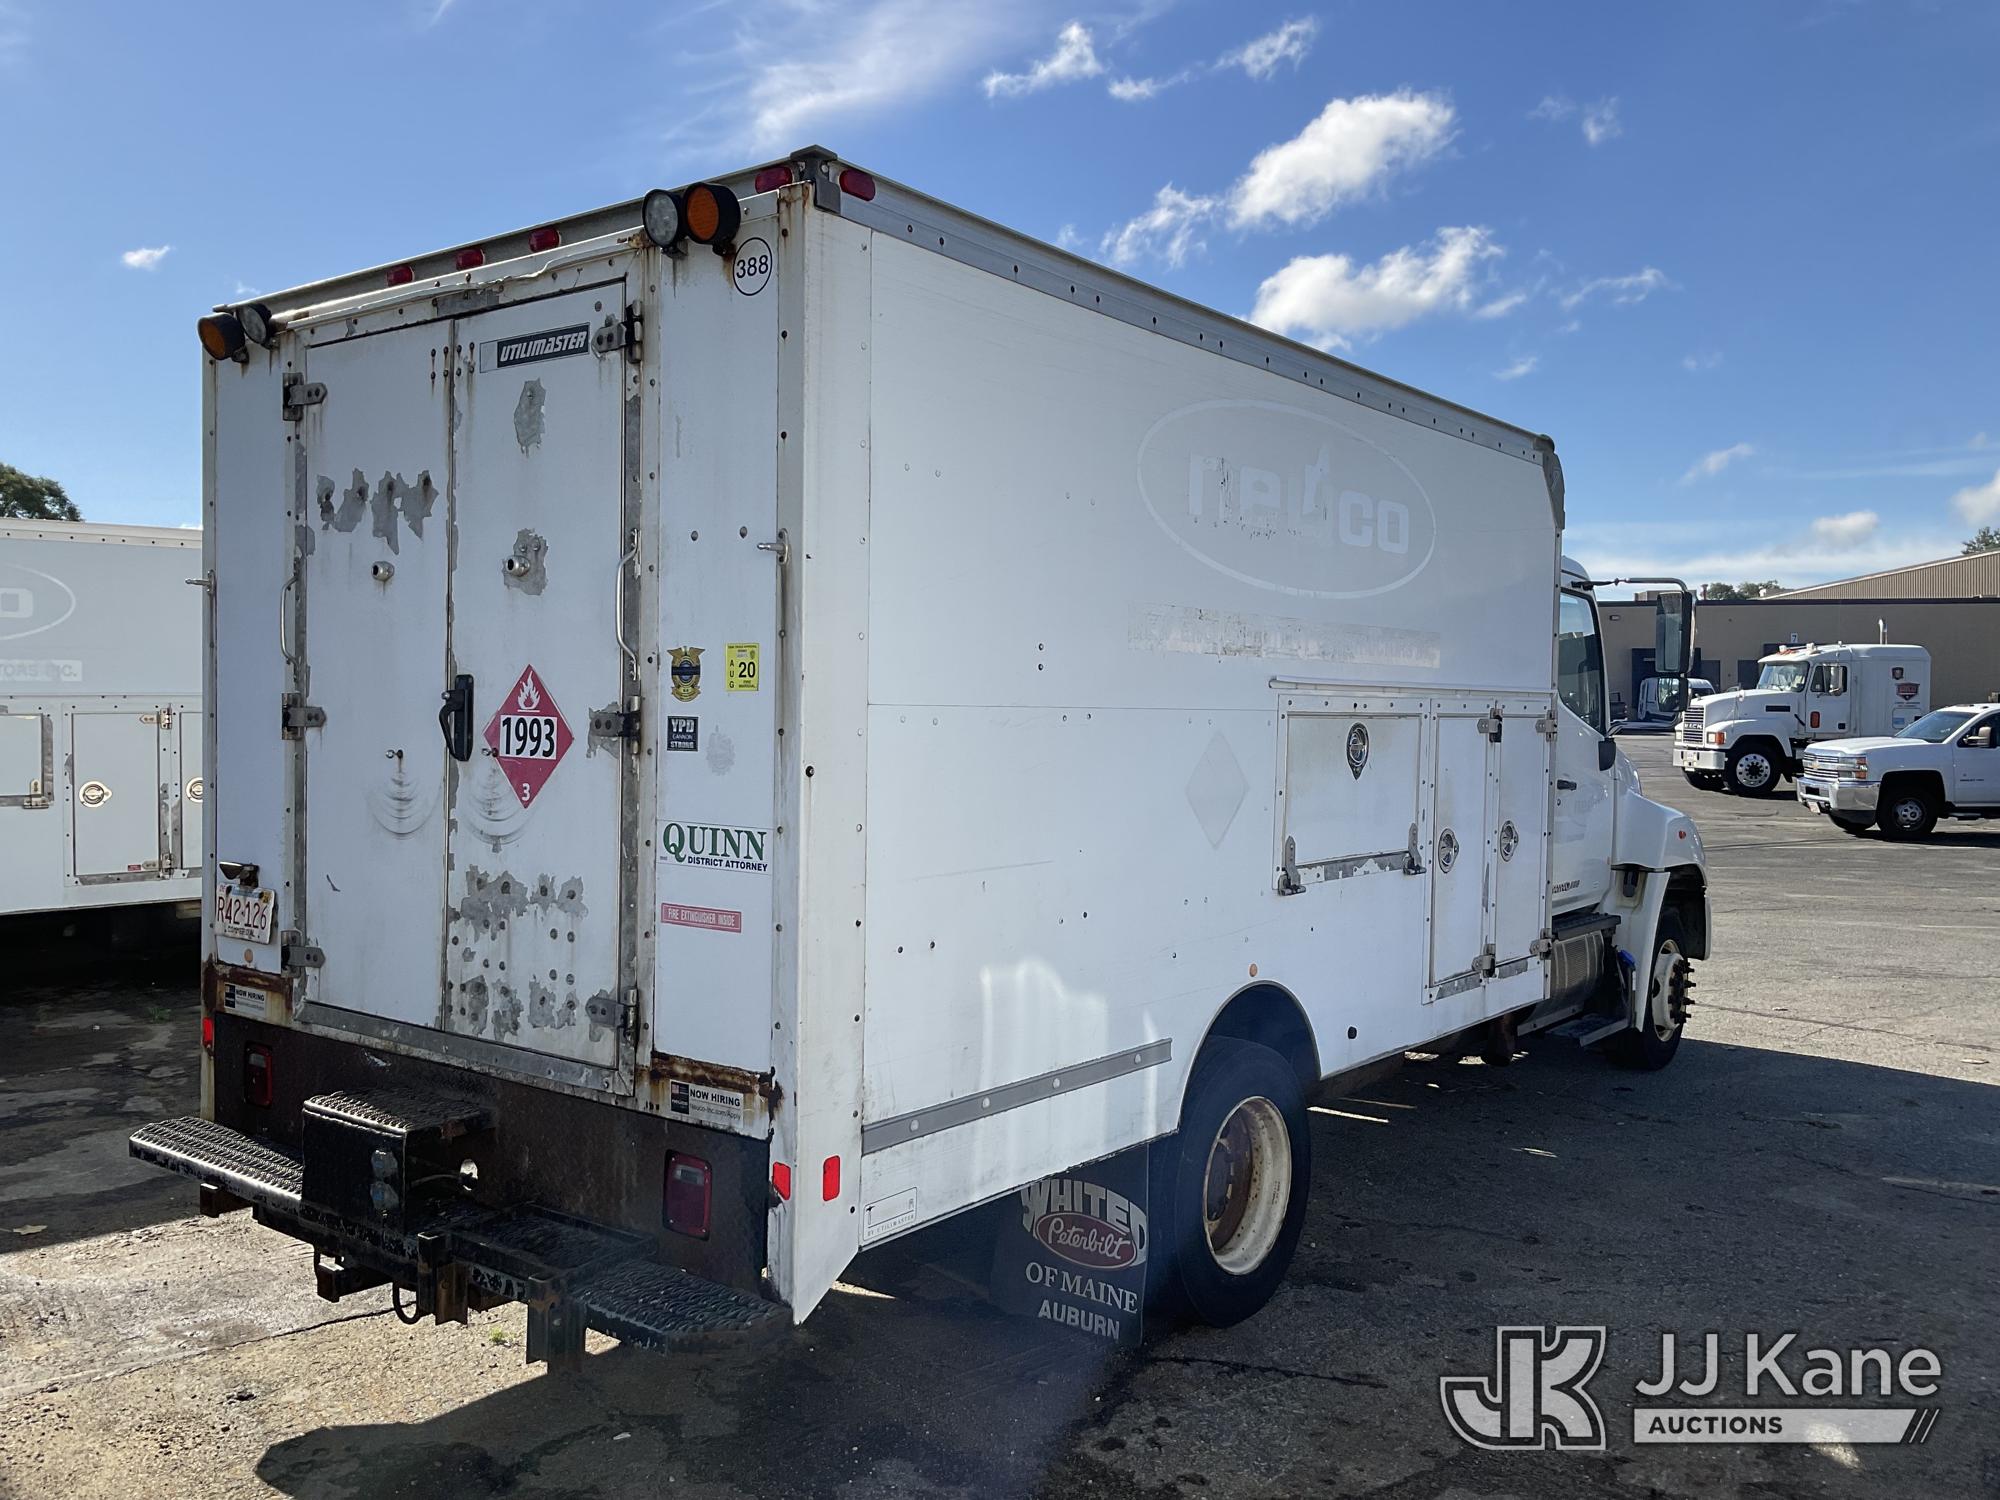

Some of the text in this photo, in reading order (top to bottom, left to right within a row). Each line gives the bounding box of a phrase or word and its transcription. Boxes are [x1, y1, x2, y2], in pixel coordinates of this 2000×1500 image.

[736, 254, 770, 279] 388
[738, 661, 756, 678] 20
[502, 716, 555, 757] 1993
[671, 719, 695, 733] YPD
[521, 783, 531, 801] 3
[663, 823, 767, 862] QUINN
[725, 860, 767, 871] ATTORNEY
[668, 908, 679, 919] FIRE
[717, 914, 735, 926] INSIDE
[689, 1089, 740, 1106] NOW HIRING
[1049, 1217, 1131, 1260] Peterbilt
[1025, 1262, 1138, 1315] OF MAINE
[1038, 1300, 1120, 1340] AUBURN
